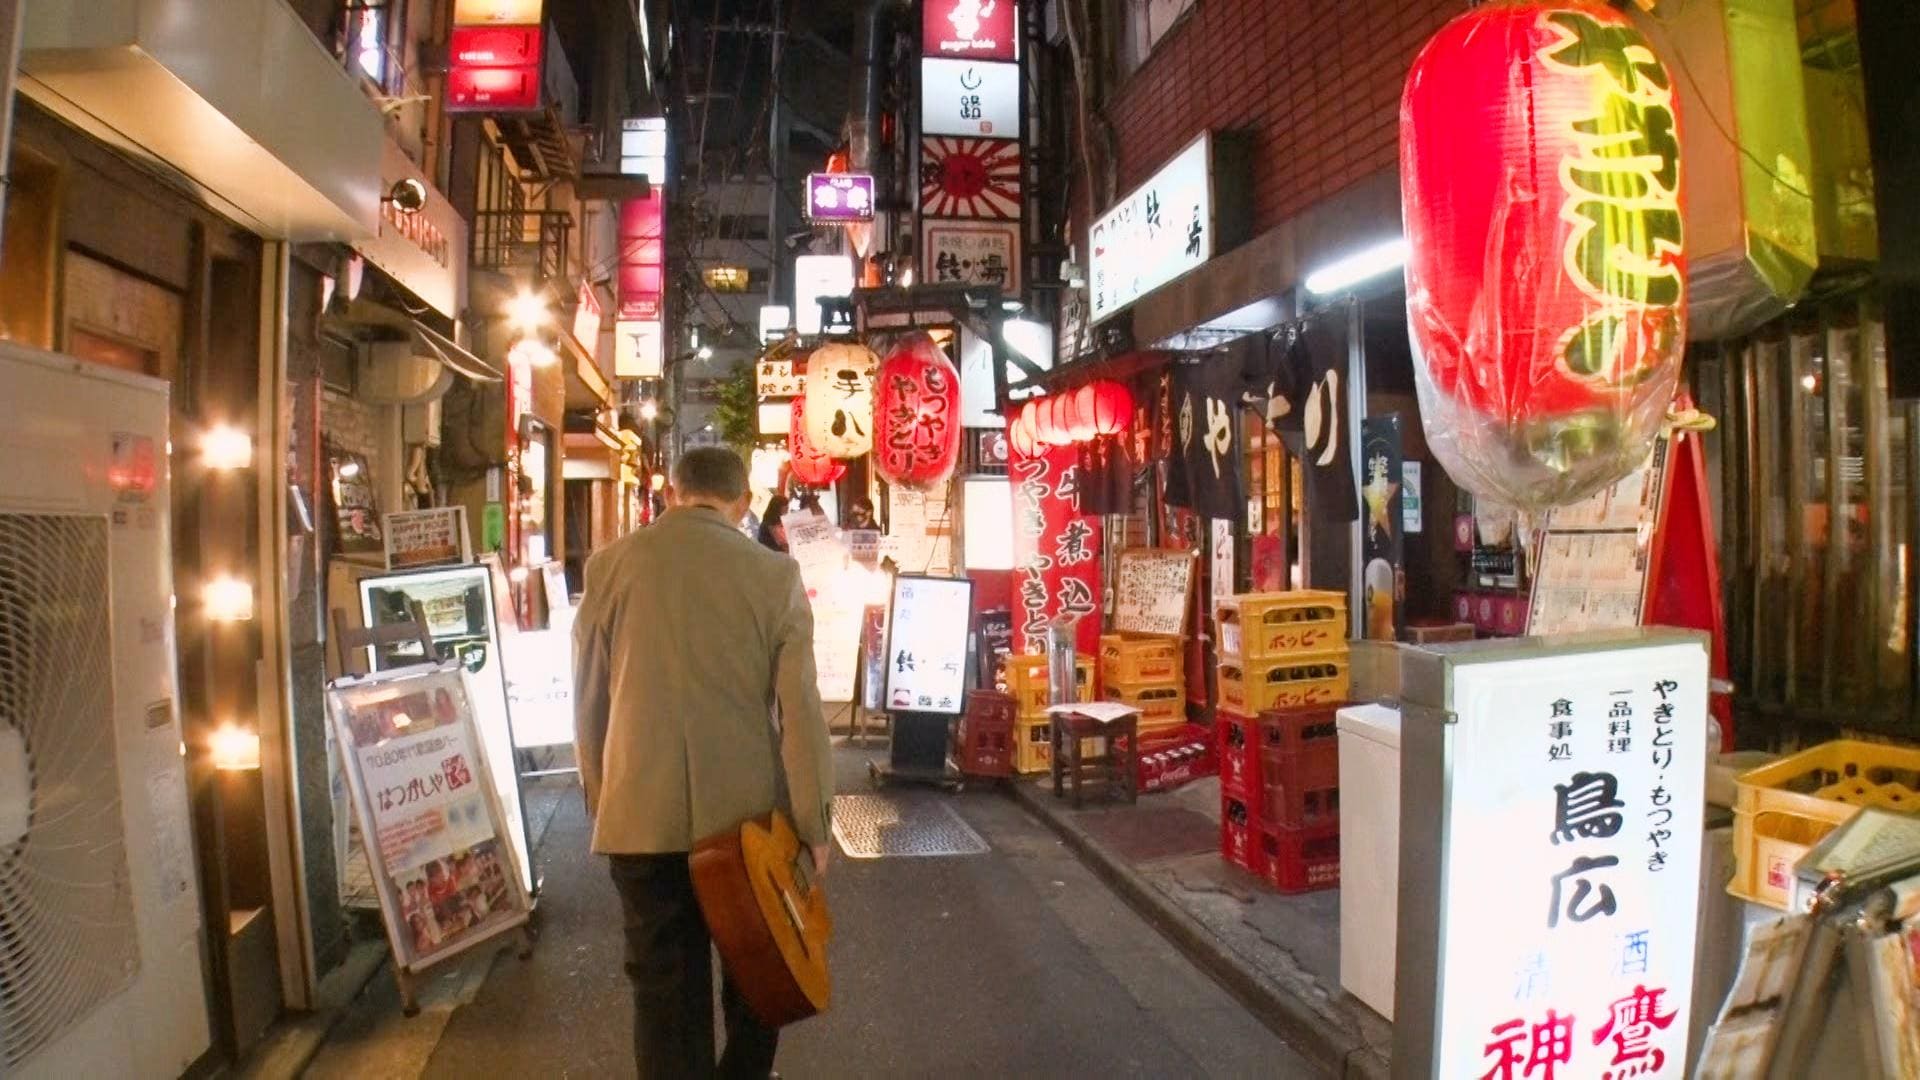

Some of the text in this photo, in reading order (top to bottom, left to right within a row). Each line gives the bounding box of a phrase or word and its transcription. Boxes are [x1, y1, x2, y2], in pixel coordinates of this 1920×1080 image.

[889, 374, 918, 472] やきとり
[917, 364, 947, 465] もつやき
[1055, 465, 1095, 615] 牛煮込
[1548, 698, 1574, 762] 食事処
[1606, 688, 1634, 754] 一品料理
[1547, 771, 1626, 930] 鳥広
